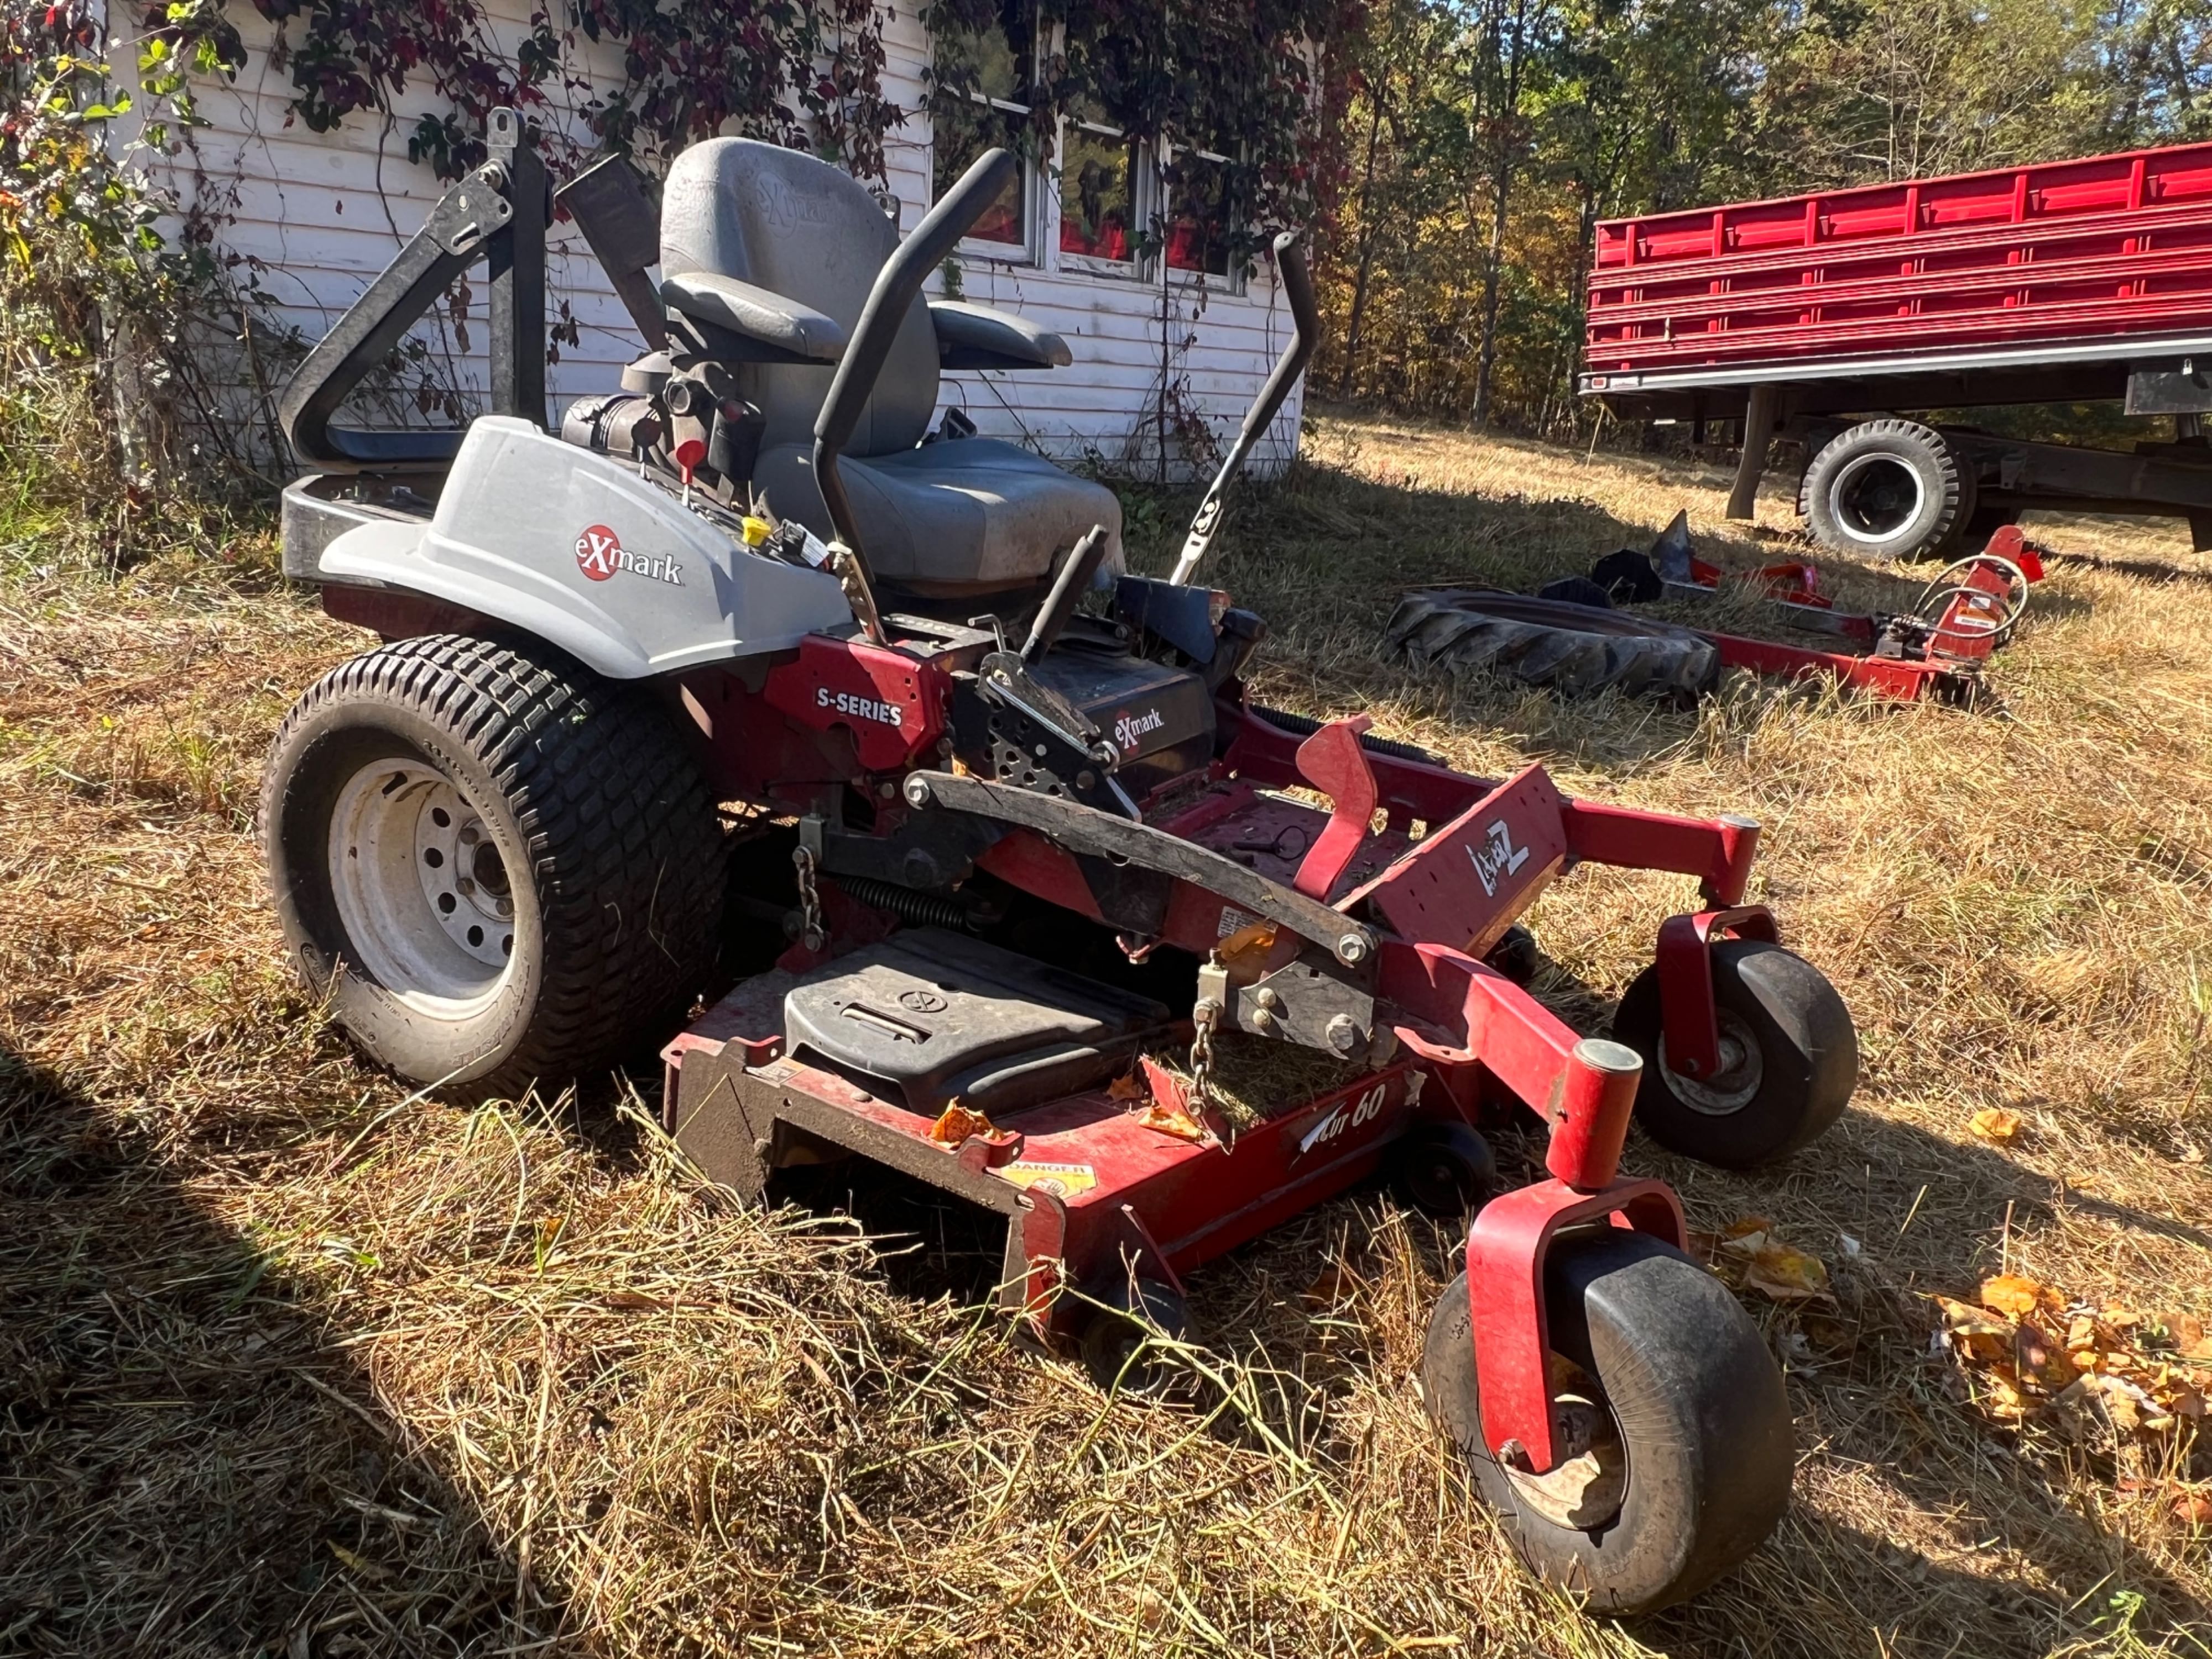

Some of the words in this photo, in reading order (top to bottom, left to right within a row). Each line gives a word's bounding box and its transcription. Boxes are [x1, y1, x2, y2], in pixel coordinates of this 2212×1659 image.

[575, 533, 683, 585] eXmark
[817, 687, 902, 726] S-SERIES
[1115, 708, 1162, 749] eXmark
[1486, 820, 1530, 877] Z
[1352, 1083, 1386, 1127] 60
[1008, 1163, 1086, 1173] DANGER
